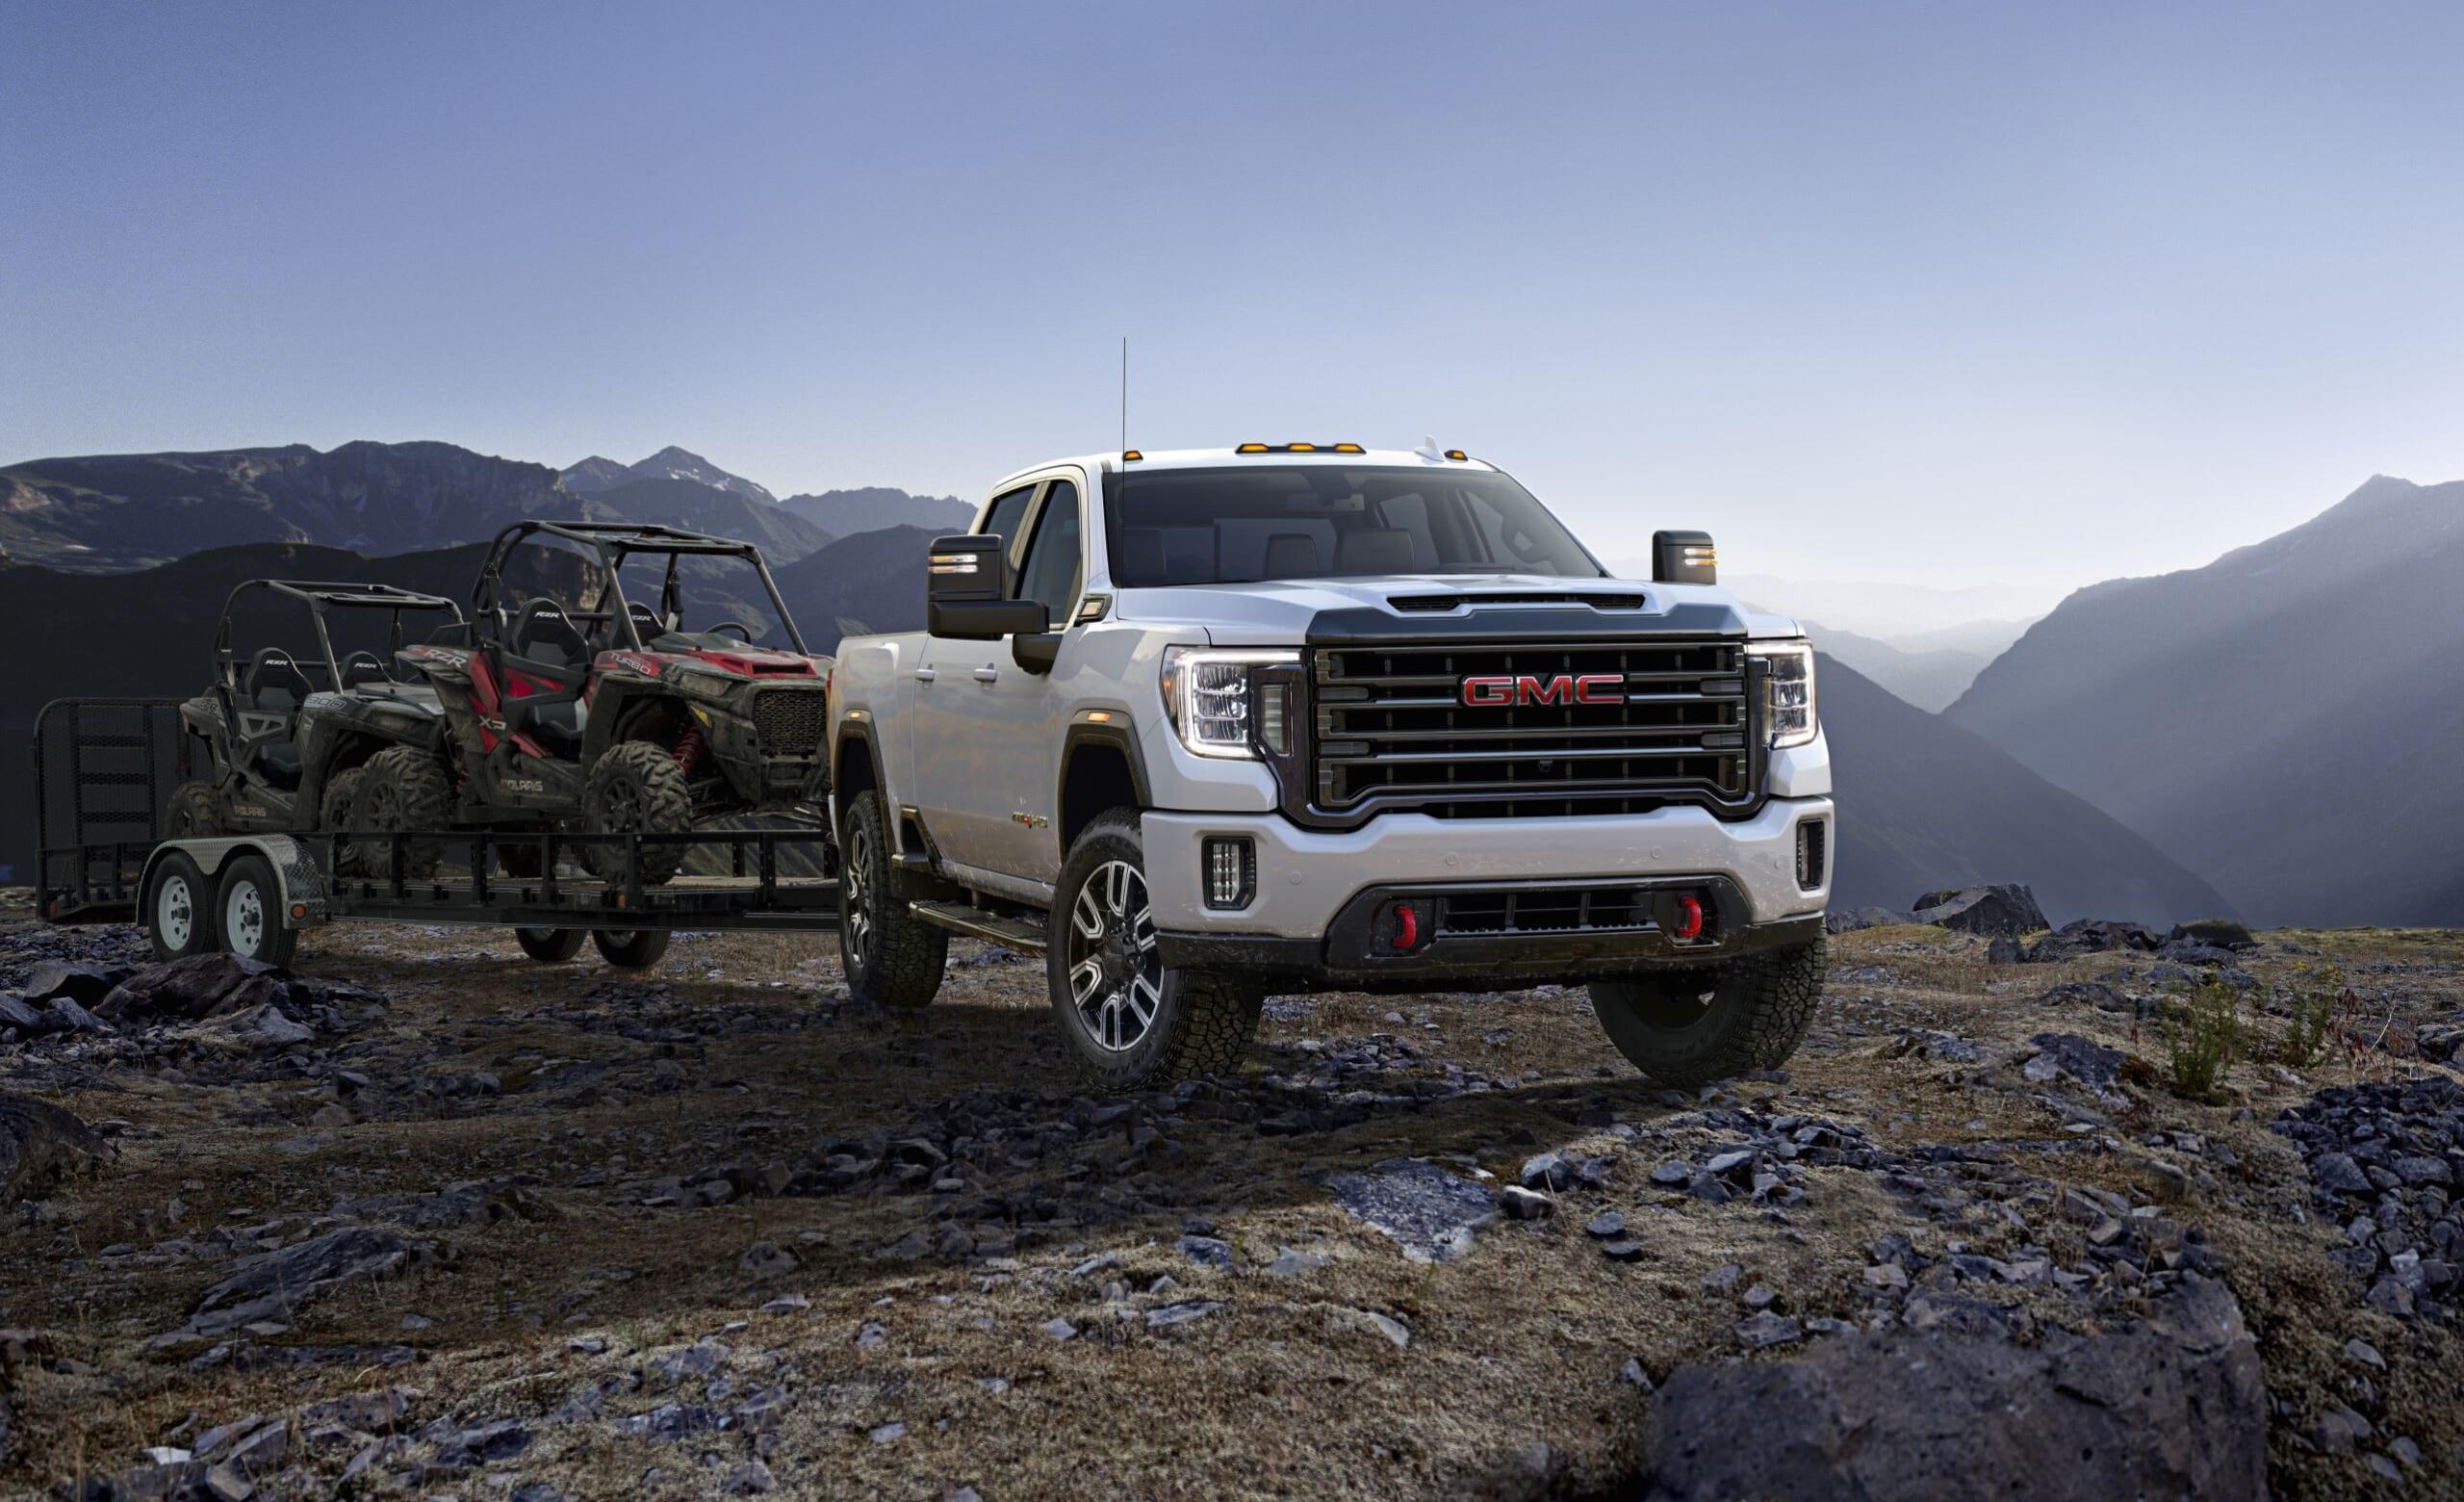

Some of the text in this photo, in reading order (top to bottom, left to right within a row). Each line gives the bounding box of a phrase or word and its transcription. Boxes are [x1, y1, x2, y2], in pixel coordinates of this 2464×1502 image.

[534, 610, 561, 619] RZR
[424, 649, 467, 668] RZR
[610, 653, 652, 675] TURBO
[1462, 674, 1625, 707] GMC
[478, 714, 506, 731] XP
[500, 778, 544, 791] POLARIS
[233, 805, 267, 816] POLARIS
